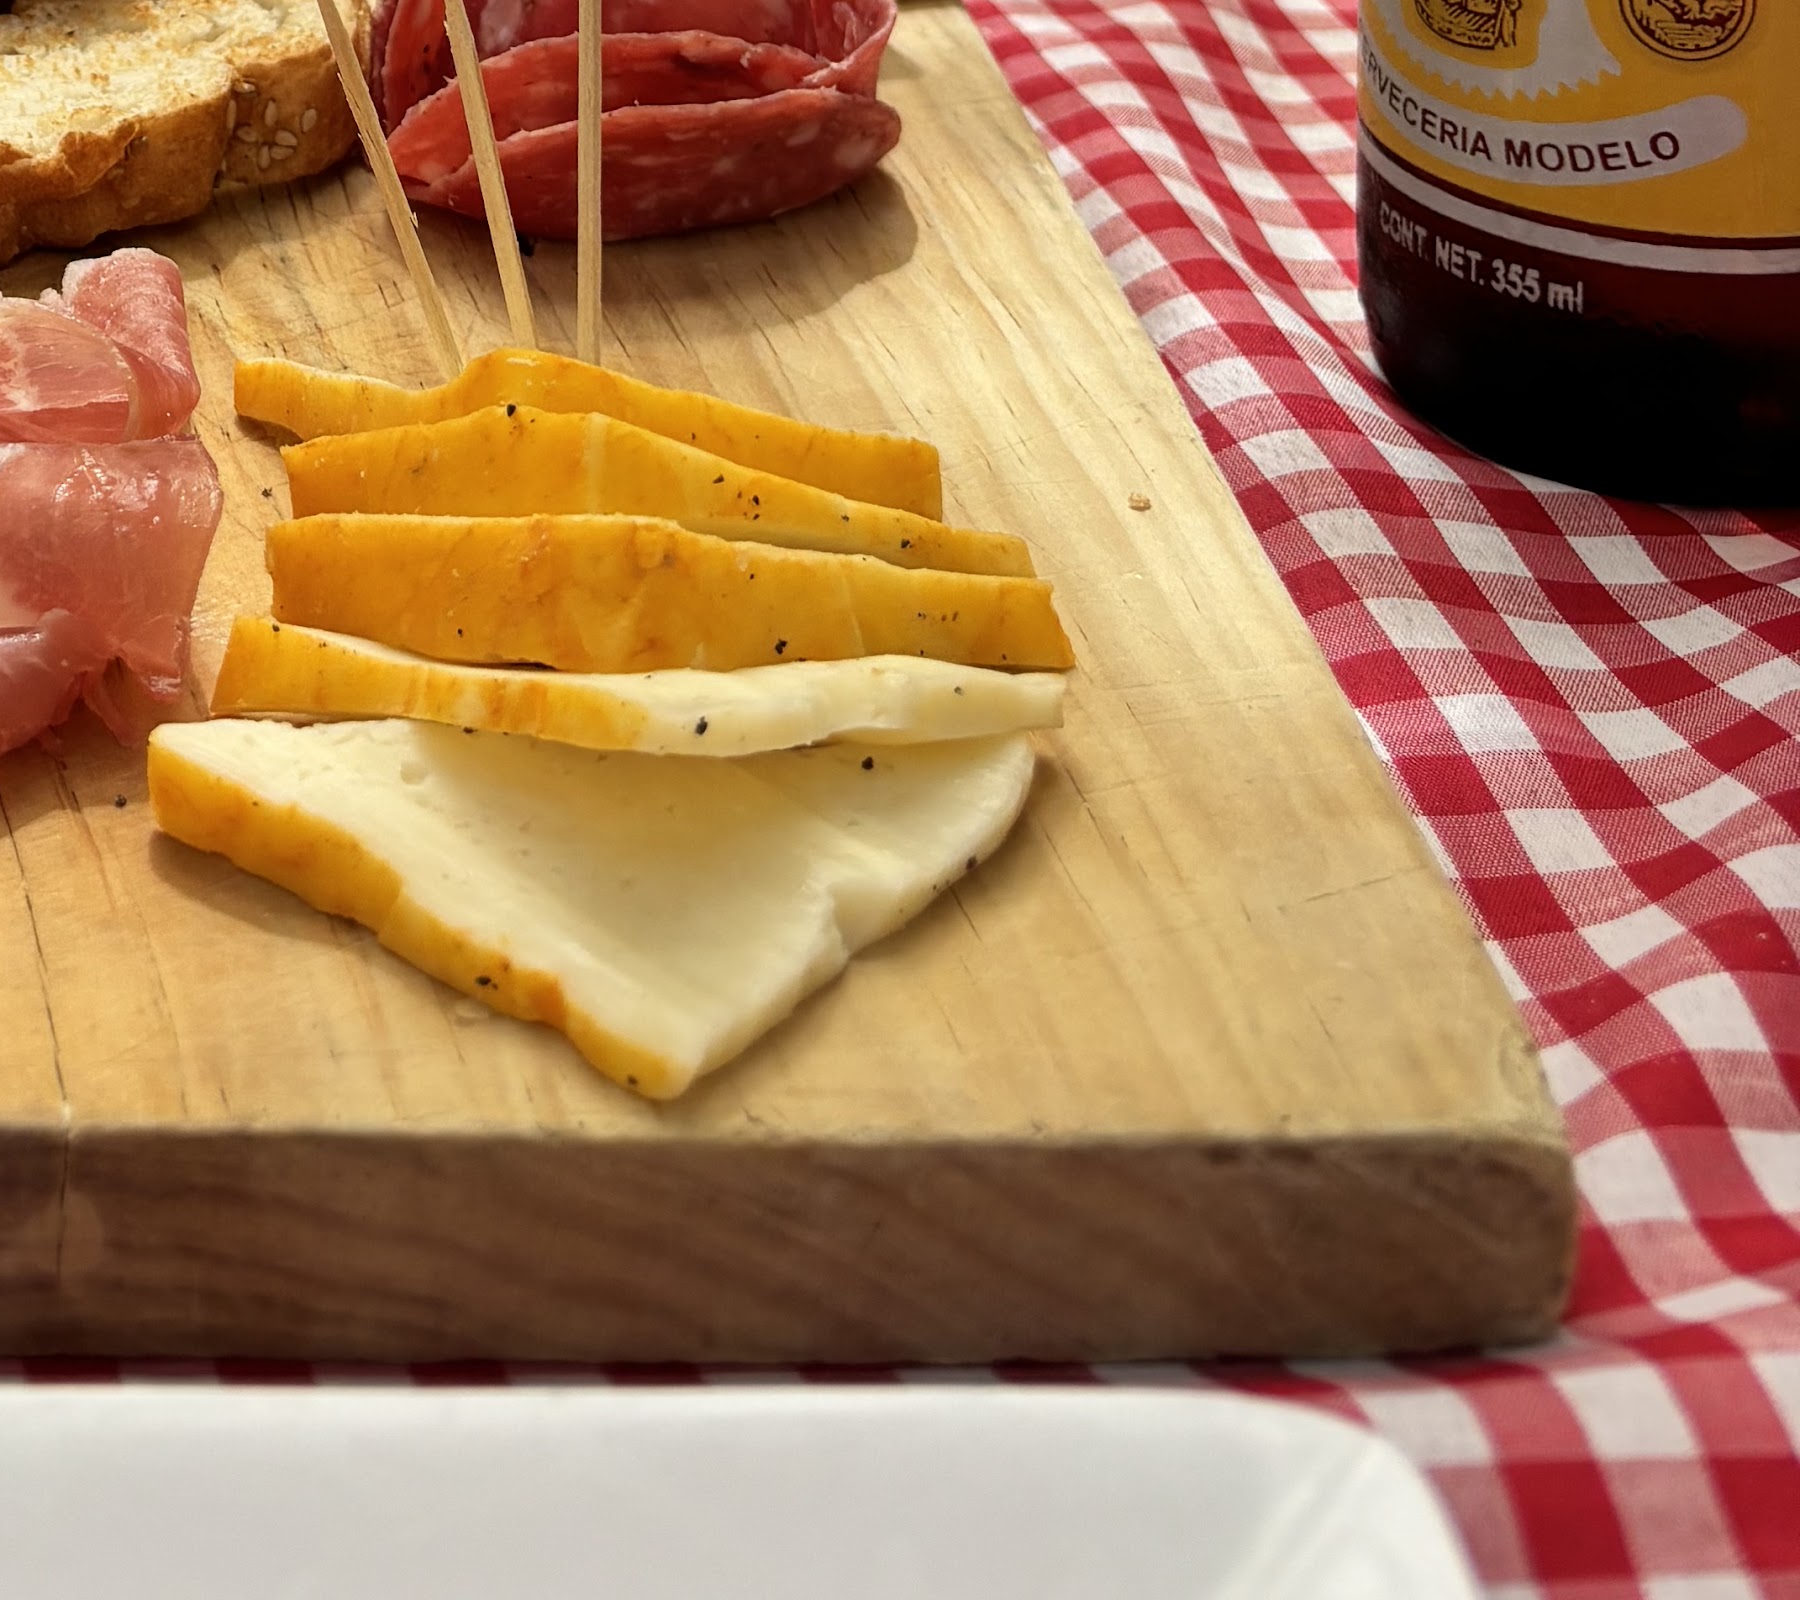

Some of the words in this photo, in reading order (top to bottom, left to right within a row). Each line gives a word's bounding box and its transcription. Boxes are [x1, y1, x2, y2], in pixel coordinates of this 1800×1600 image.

[1360, 22, 1492, 161] ERVECERIA
[1505, 131, 1680, 173] MODELO
[1435, 235, 1485, 286] NET.
[1491, 258, 1541, 303] 355
[1547, 280, 1584, 314] ml
